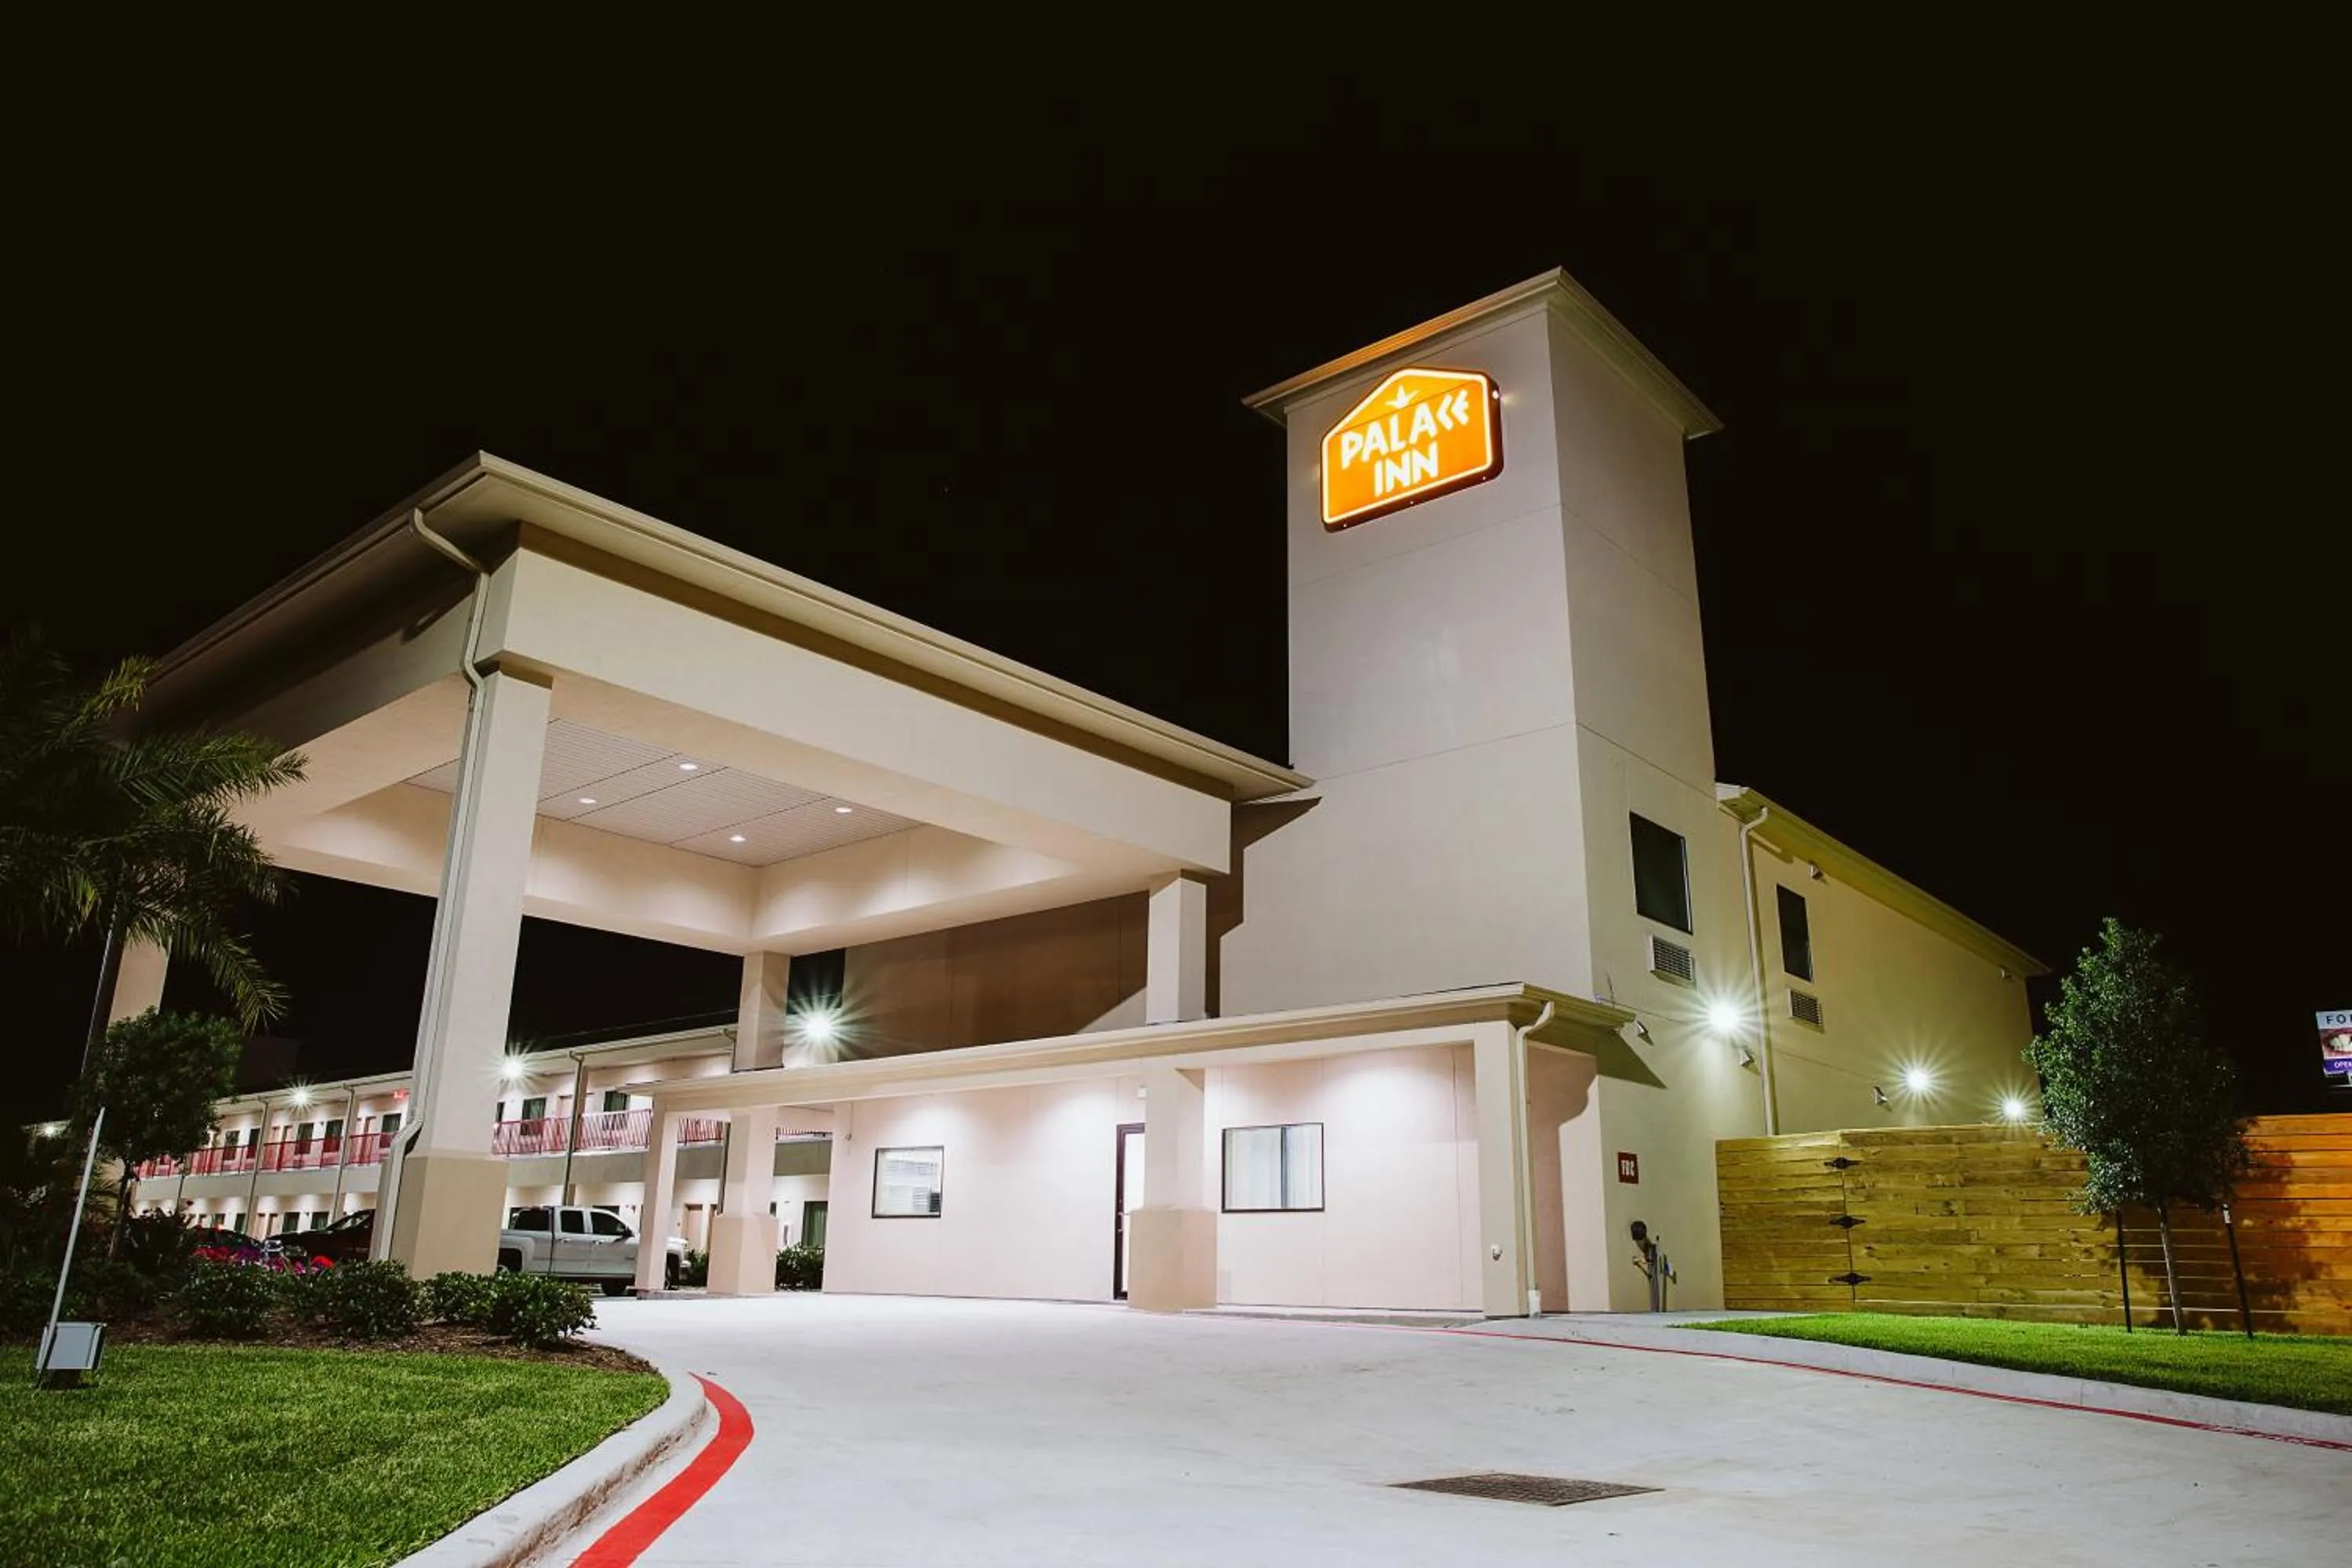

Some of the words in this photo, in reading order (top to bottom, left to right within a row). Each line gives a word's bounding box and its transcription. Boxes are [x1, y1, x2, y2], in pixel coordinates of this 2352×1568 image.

[1341, 389, 1468, 470] PALACE
[1374, 440, 1439, 497] INN
[2326, 1014, 2352, 1025] FO
[1621, 1160, 1635, 1177] FDC
